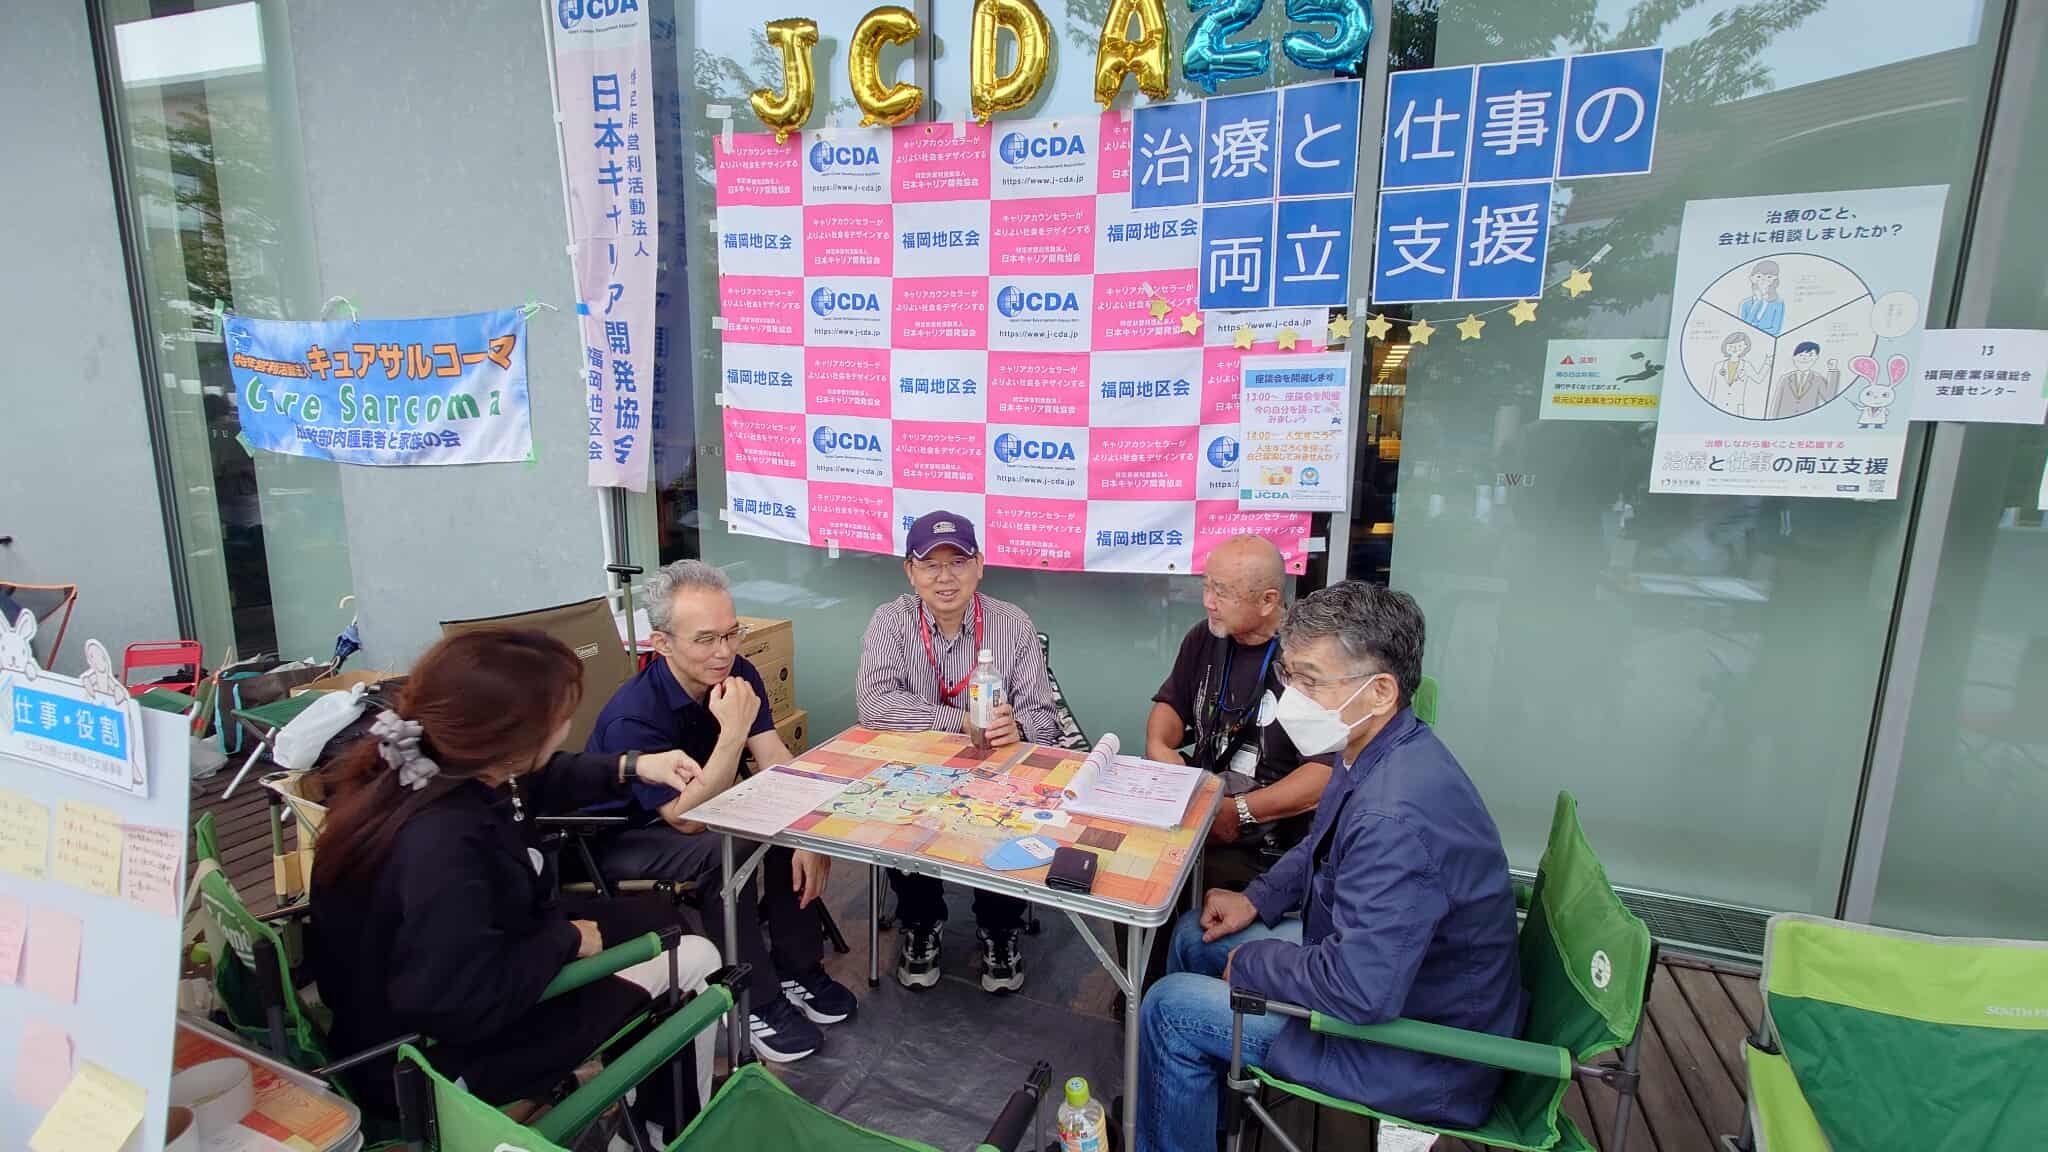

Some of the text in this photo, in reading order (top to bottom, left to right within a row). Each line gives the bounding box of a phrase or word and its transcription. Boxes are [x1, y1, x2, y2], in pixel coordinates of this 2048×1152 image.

[1140, 112, 1342, 187] 治療と
[1394, 86, 1645, 164] 仕事の
[822, 146, 880, 166] JCDA
[1014, 135, 1086, 159] JCDA
[1002, 174, 1084, 186] https://www.j-cda.jp
[1766, 206, 1858, 225] 治療のこと、
[902, 230, 980, 249] 福岡地区会
[1106, 218, 1198, 242] 福岡地区会
[1385, 202, 1540, 278] 支援
[1718, 224, 1903, 247] 会社に相談しましたか？
[724, 232, 792, 250] 福岡地区会
[1209, 223, 1341, 295] 両立
[1104, 283, 1194, 296] キャリアカンセラーが
[824, 292, 880, 312] JCDA
[1012, 292, 1080, 312] JCDA
[999, 329, 1079, 339] https://www.j-cda.jp
[306, 334, 517, 380] キュアサルコーマ
[727, 368, 793, 387] 福岡地区会
[899, 377, 977, 395] 福岡地区会
[1924, 370, 2032, 382] 福岡産業保健総合
[1100, 378, 1191, 399] 福岡地区会
[1936, 386, 2017, 396] 支援センター
[826, 432, 882, 452] JCDA
[1009, 440, 1076, 461] JCDA
[1662, 450, 1889, 476] 治療と仕事の両立支援
[733, 498, 797, 520] 福岡地区会
[1096, 529, 1183, 547] 福岡地区会
